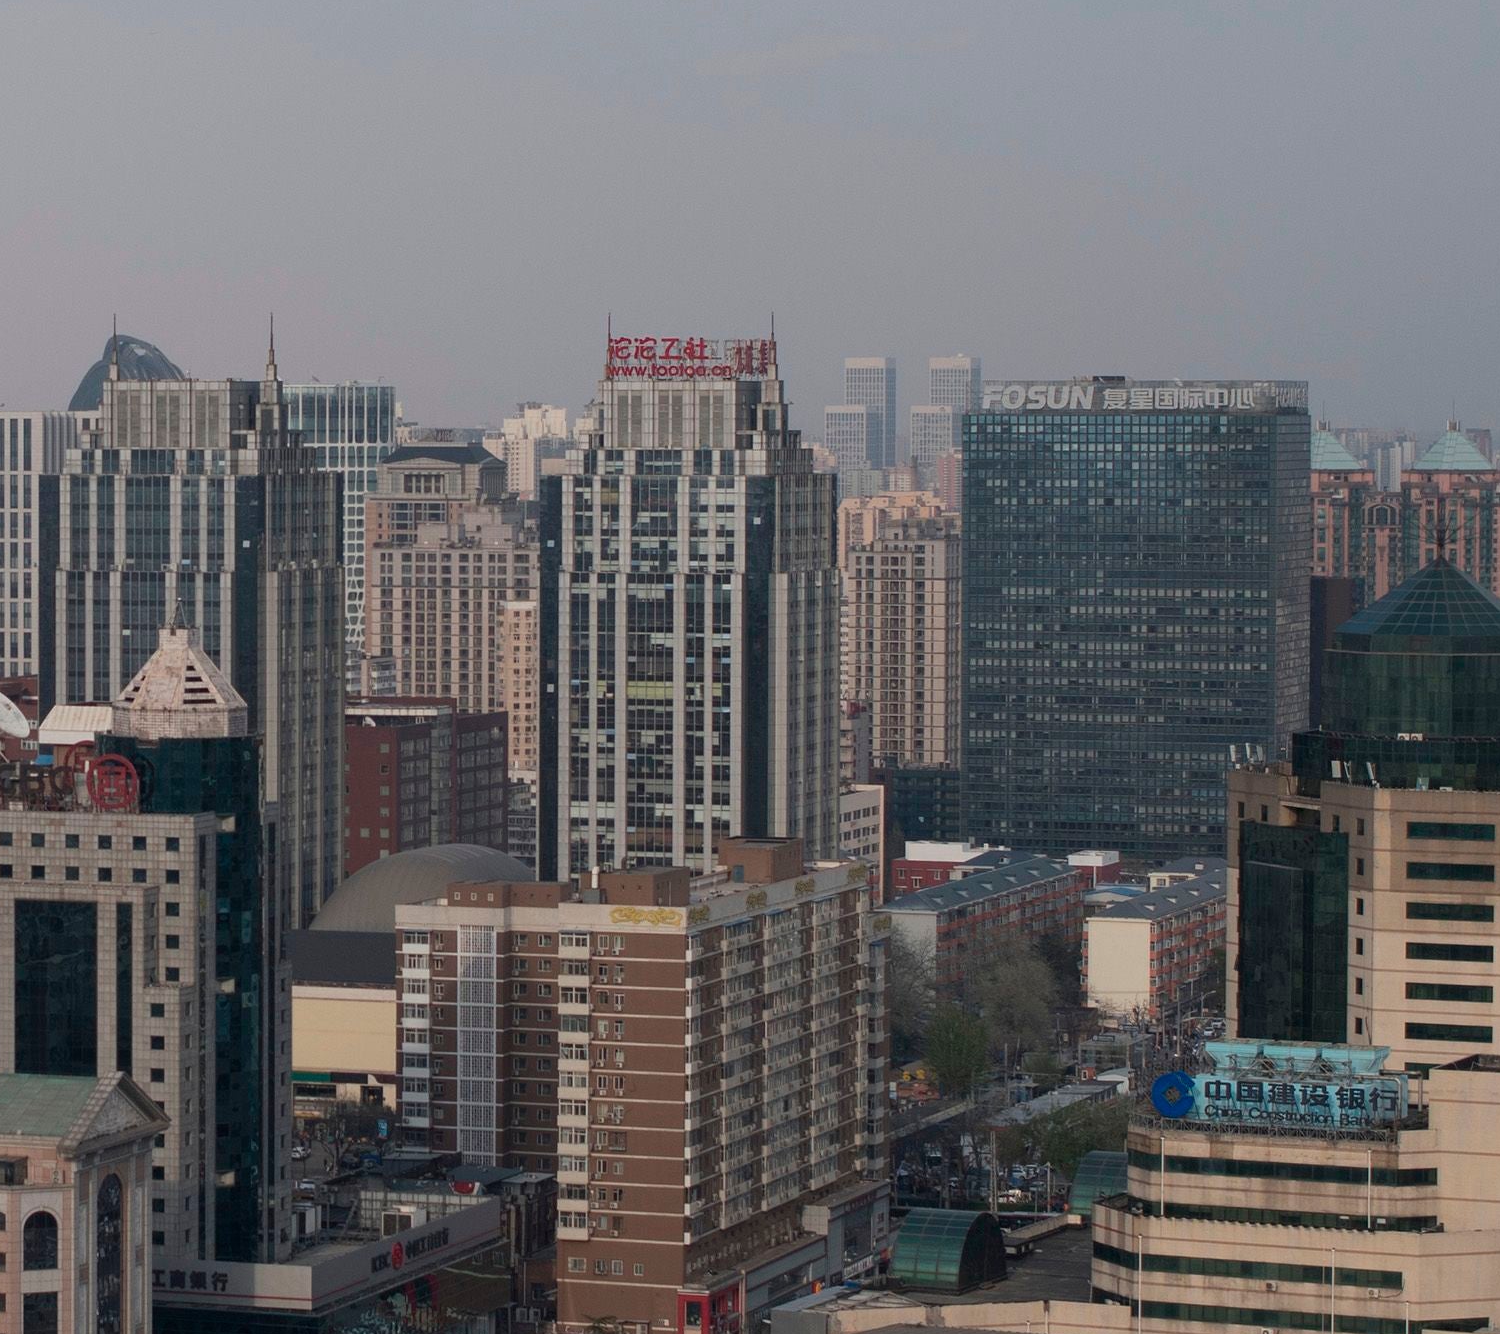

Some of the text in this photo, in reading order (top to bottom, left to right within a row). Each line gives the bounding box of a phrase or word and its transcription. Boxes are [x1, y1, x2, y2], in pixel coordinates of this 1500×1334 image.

[982, 385, 1095, 410] FOSUN
[1103, 387, 1254, 410] 复星国际中心
[1204, 1080, 1400, 1112] 中国建设银行
[1204, 1104, 1242, 1118] China
[1249, 1107, 1334, 1125] Construction
